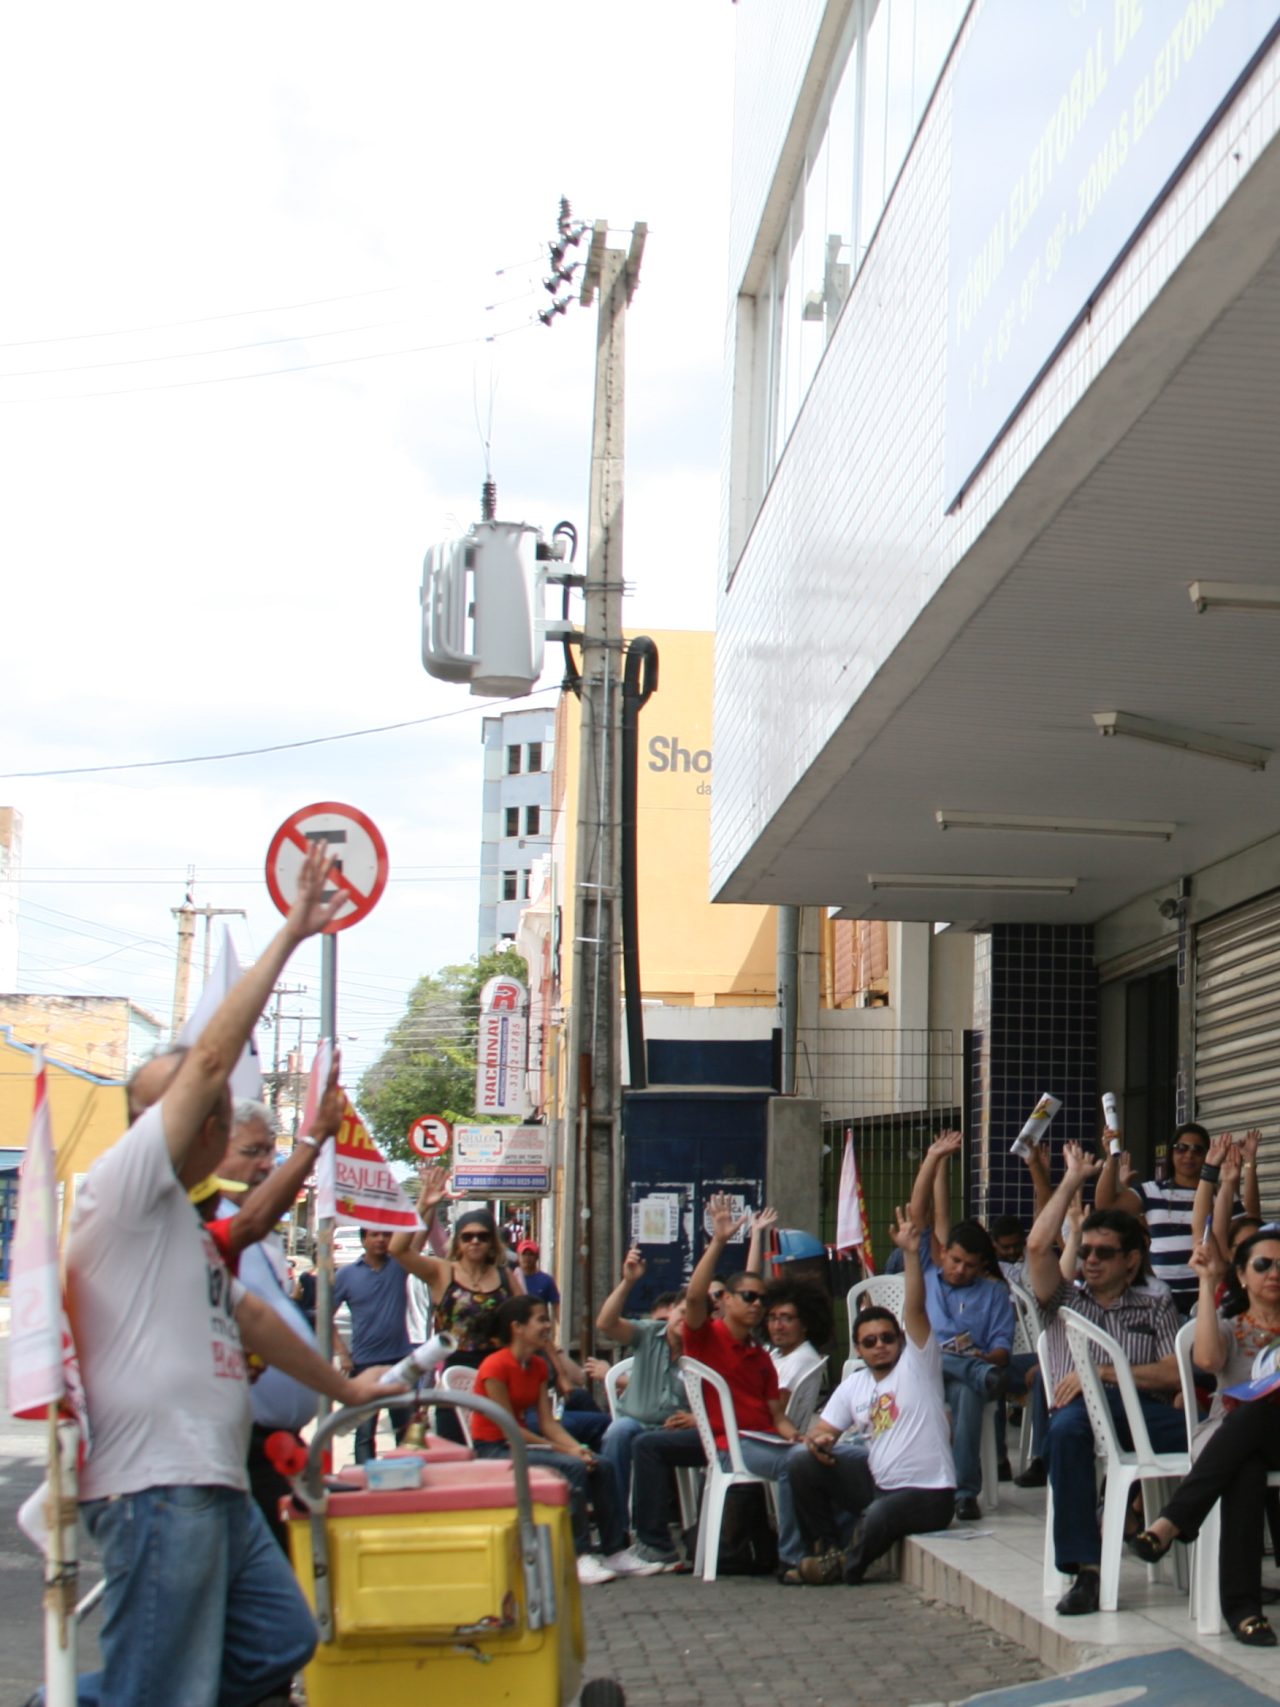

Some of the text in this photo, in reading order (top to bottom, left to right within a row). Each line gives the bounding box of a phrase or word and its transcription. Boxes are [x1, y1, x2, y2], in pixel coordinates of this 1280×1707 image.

[1009, 27, 1107, 253] ELEITORAL
[1077, 107, 1128, 236] ZONAS
[648, 735, 712, 773] Sho
[484, 1016, 500, 1107] RACIONAL
[423, 1125, 437, 1148] E
